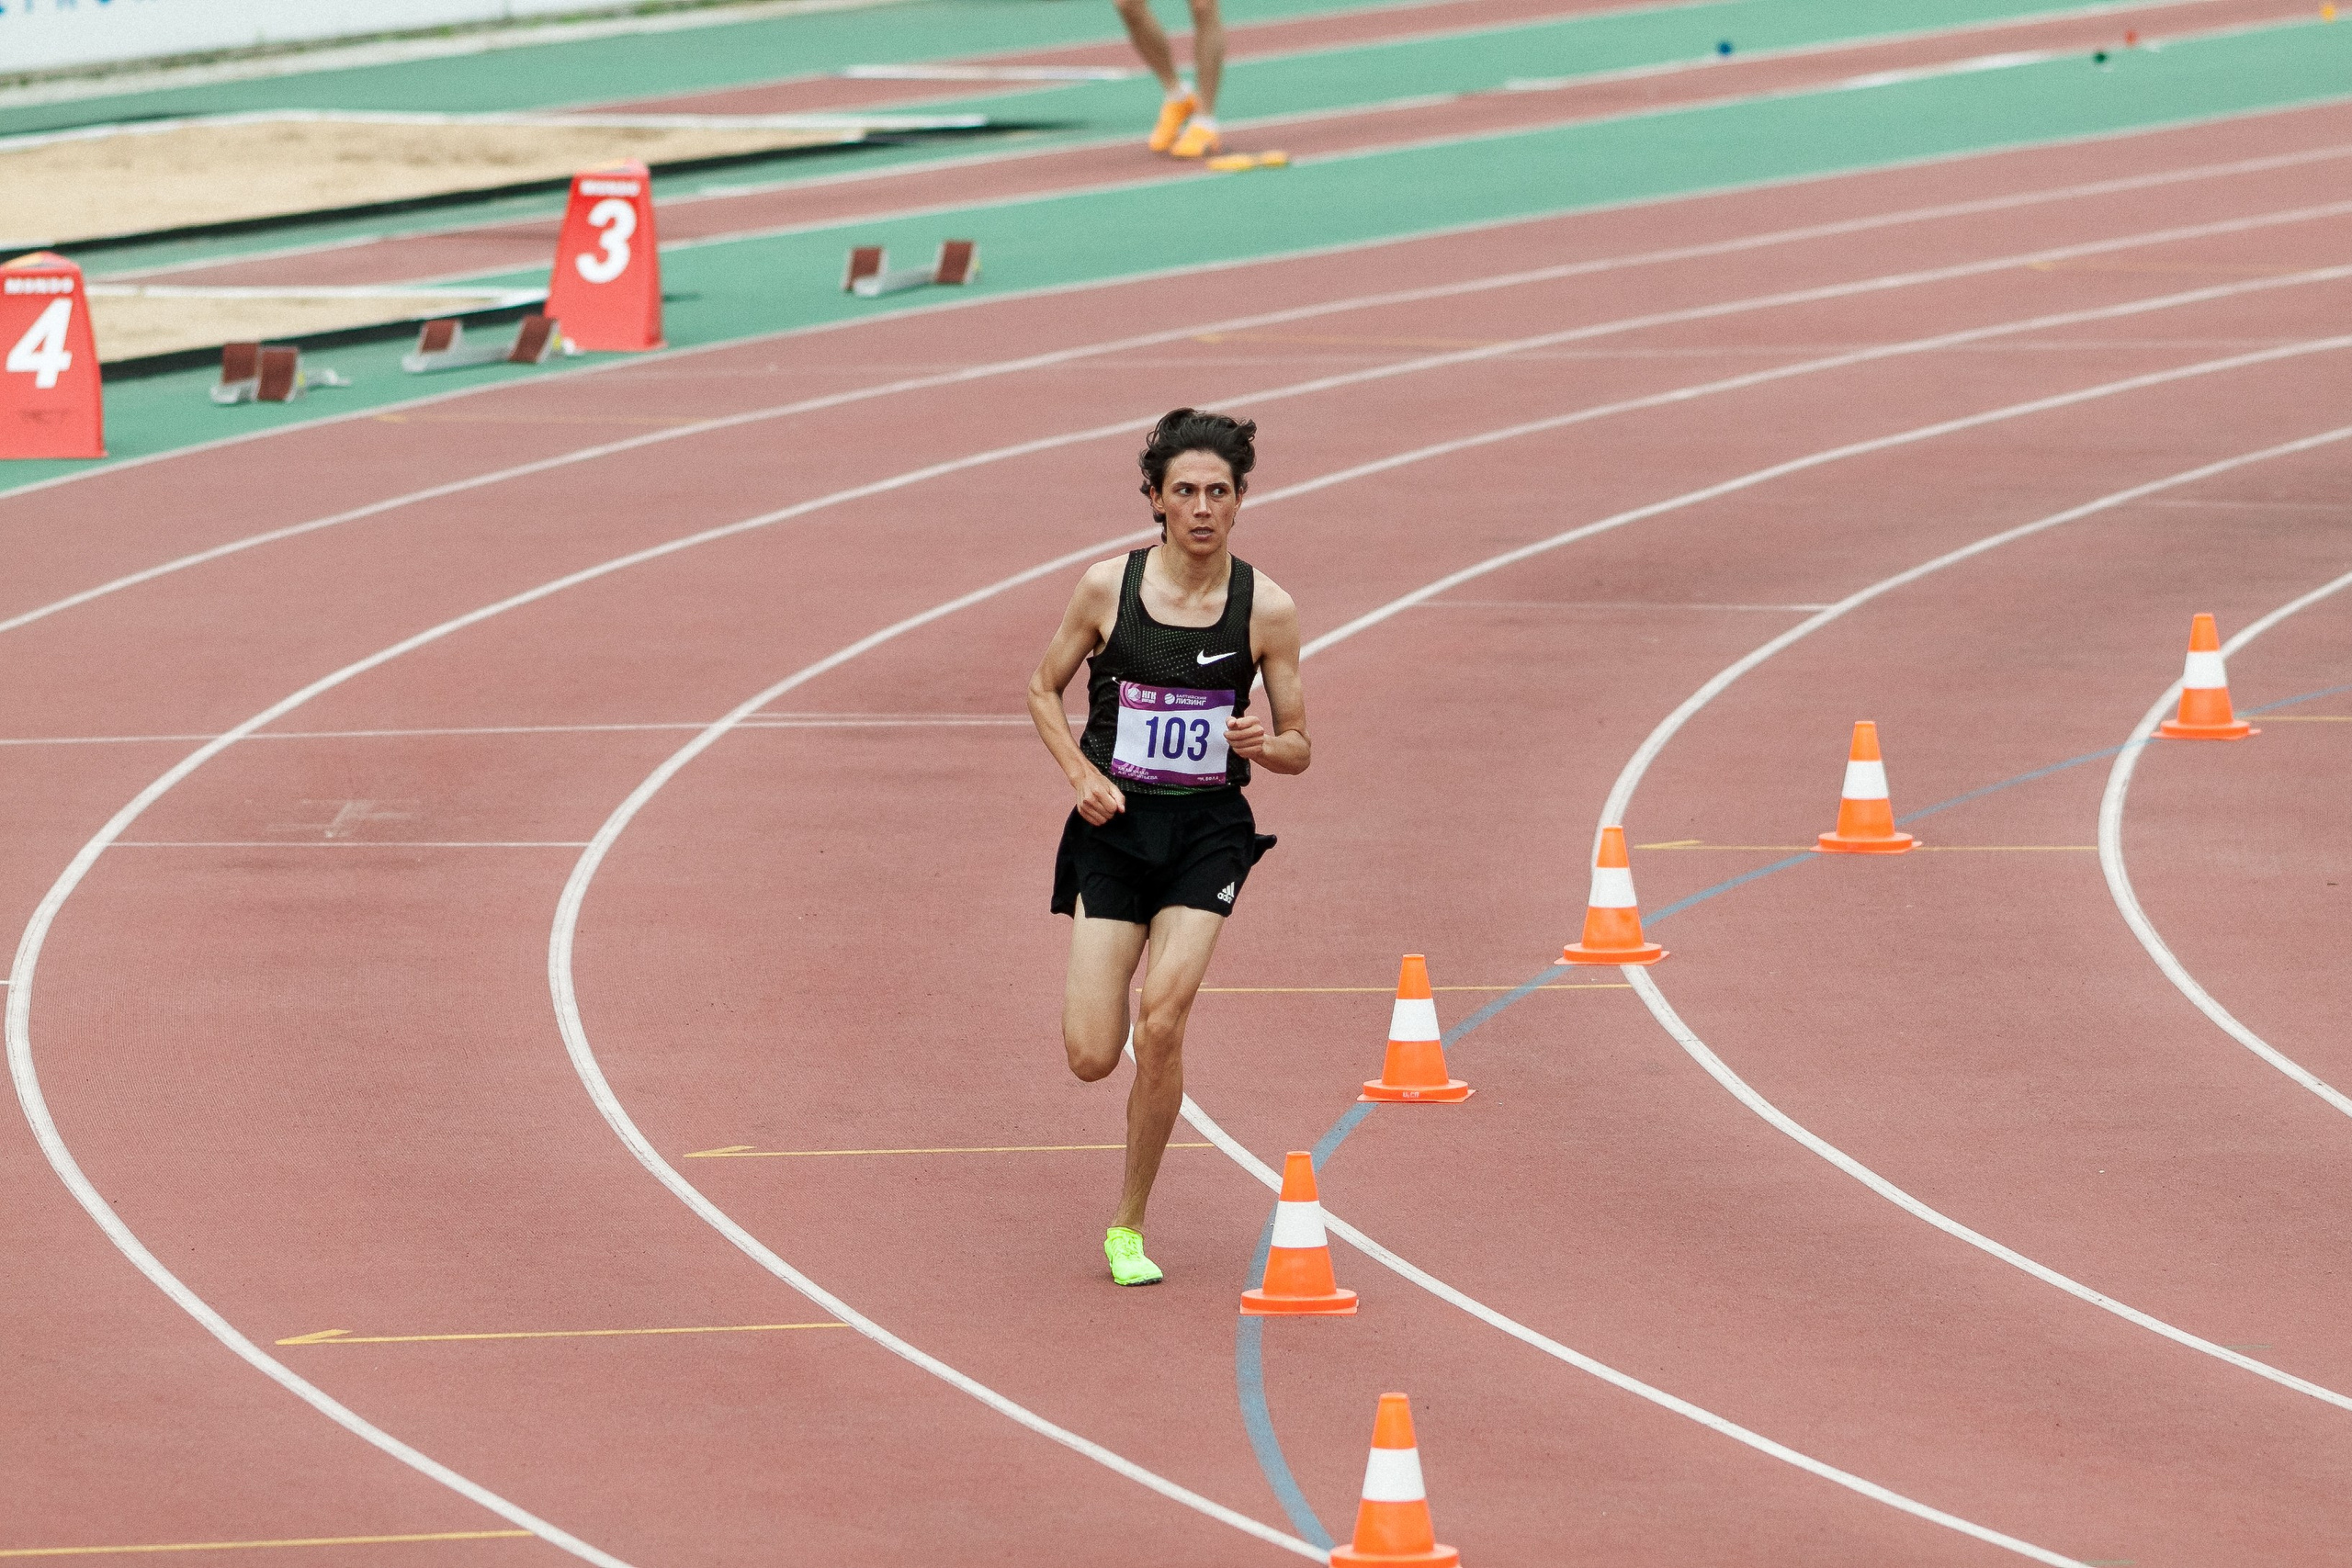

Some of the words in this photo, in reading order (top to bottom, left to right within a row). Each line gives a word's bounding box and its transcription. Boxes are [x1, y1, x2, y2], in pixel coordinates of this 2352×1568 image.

[575, 198, 638, 284] 3
[6, 298, 73, 389] 4
[1146, 716, 1210, 761] 103
